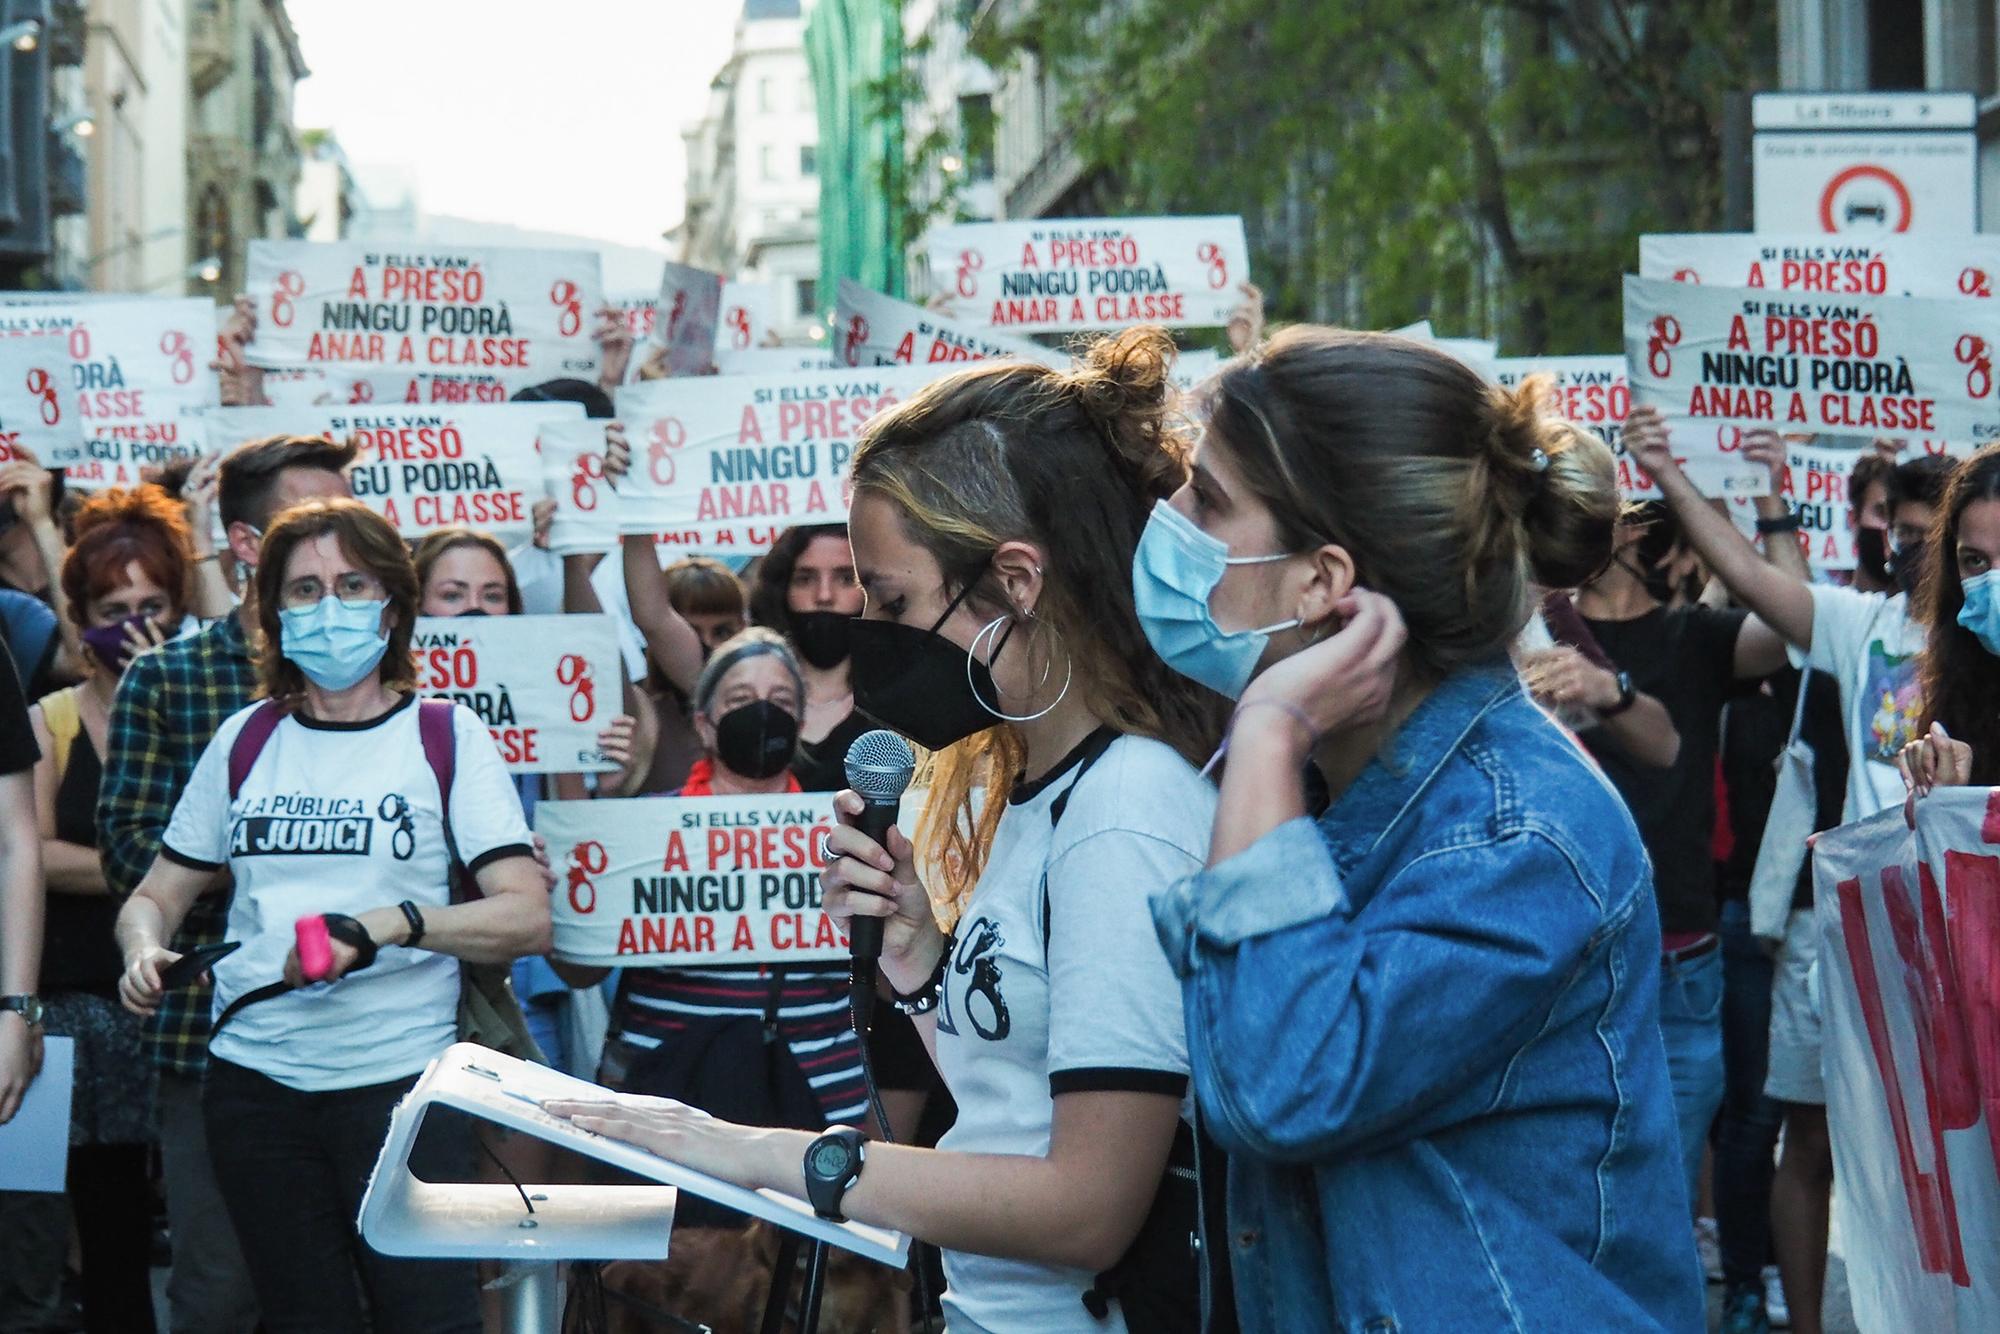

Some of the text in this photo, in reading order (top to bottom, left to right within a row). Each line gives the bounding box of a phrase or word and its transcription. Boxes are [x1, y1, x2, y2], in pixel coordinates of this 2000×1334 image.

[1022, 242, 1039, 269] A
[1761, 248, 1870, 261] SI ELLS VAN
[348, 261, 484, 304] A PRESÓ
[1088, 261, 1168, 294] PODRÀ
[1747, 252, 1888, 296] A PRESÓ
[421, 298, 512, 336] PODRÀ
[991, 299, 1058, 326] ANAR
[1070, 297, 1086, 321] A
[1096, 294, 1185, 320] CLASSE
[1742, 300, 1860, 320] SI ELLS VAN
[307, 332, 384, 362] ANAR
[398, 335, 415, 364] A
[427, 336, 531, 367] CLASSE
[895, 330, 914, 364] A
[1727, 312, 1879, 359] A PRESÓ
[72, 353, 125, 390] DRÀ
[1573, 371, 1613, 385] VAN
[1702, 350, 1915, 396] NINGÚ PODRÀ
[80, 389, 145, 419] ASSE
[404, 378, 420, 403] A
[754, 382, 881, 403] SI ELLS VAN
[1551, 376, 1633, 422] ESÓ
[1688, 385, 1774, 421] ANAR
[1787, 392, 1808, 424] A
[1820, 393, 1937, 432] CLASSE
[330, 416, 441, 430] SI ELLS VAN
[738, 404, 764, 445] A
[404, 455, 502, 496] PODRÀ
[710, 438, 817, 484] NINGÚ
[384, 492, 525, 528] A CLASSE
[696, 482, 791, 523] ANAR
[806, 480, 828, 514] A
[1822, 535, 1839, 561] A
[415, 633, 458, 648] VAN
[414, 640, 477, 689] ESÓ
[430, 683, 517, 727] DRÀ
[242, 791, 365, 816] LA PÚBLICA
[682, 809, 814, 829] SI ELLS VAN
[256, 819, 368, 853] JUDICI
[664, 830, 690, 872] A
[633, 866, 824, 914] NINGÚ POD
[618, 912, 850, 956] ANAR A CLA
